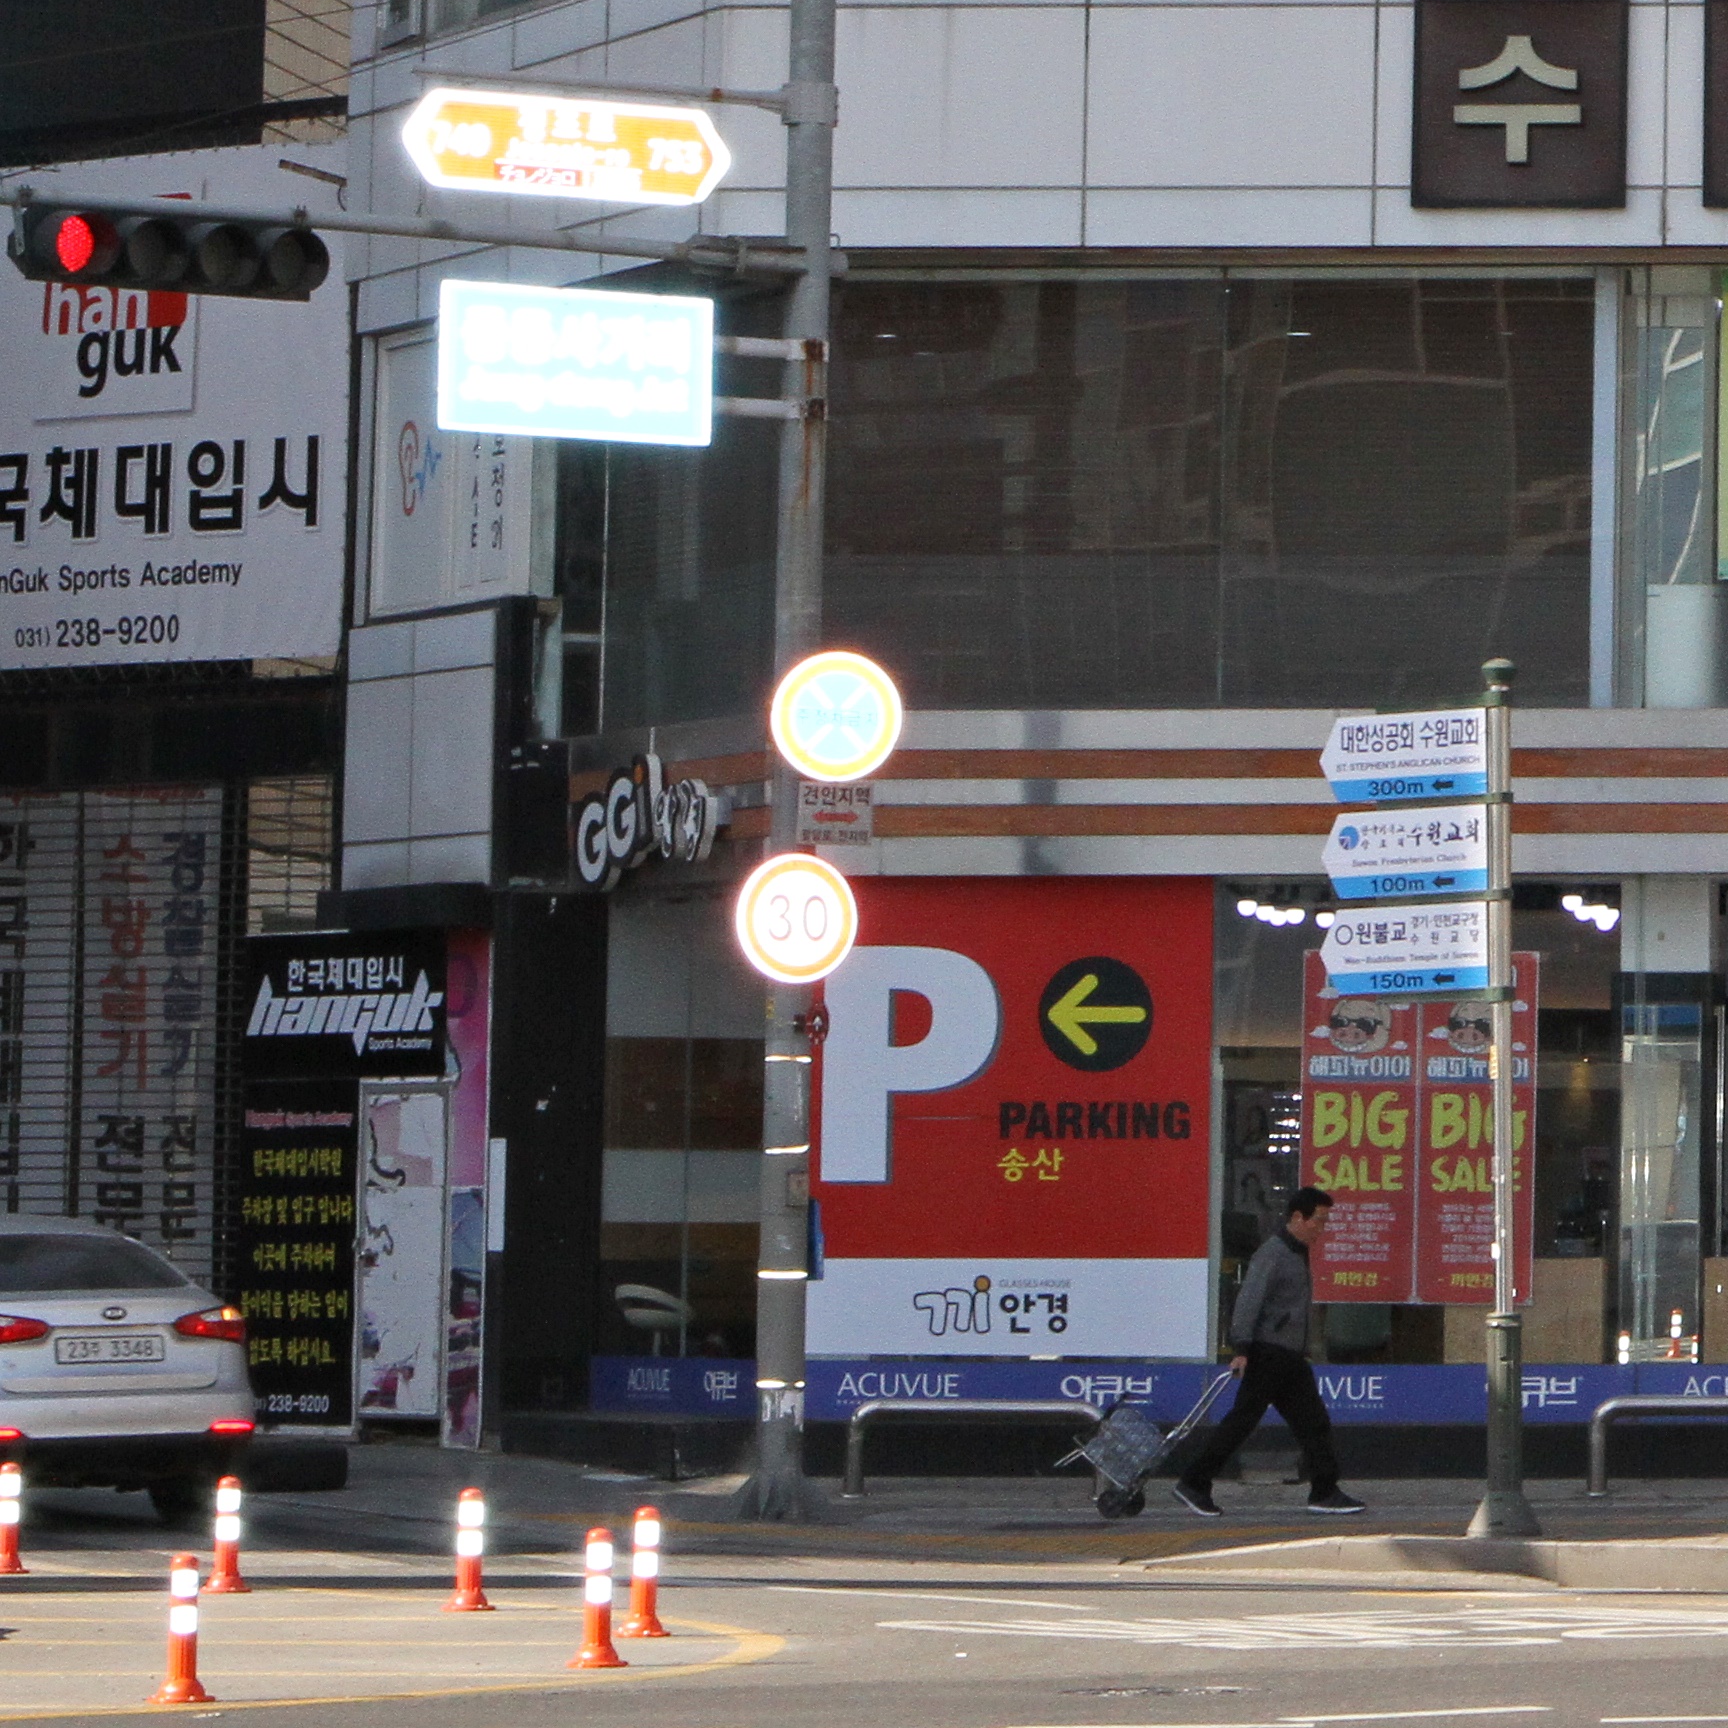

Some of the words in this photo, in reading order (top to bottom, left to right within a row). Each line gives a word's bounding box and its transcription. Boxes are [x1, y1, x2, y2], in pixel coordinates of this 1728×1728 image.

[76, 325, 182, 398] guk
[58, 563, 131, 595] Sports
[140, 558, 243, 589] Academy
[56, 613, 180, 648] 238-9200
[1341, 721, 1415, 754] 대한성공회
[1419, 717, 1480, 749] 수원교회
[803, 785, 871, 807] 견인지역
[1368, 780, 1424, 797] 300m
[1405, 818, 1480, 846] 수원교회
[1371, 877, 1425, 893] 100m
[768, 893, 827, 941] 30
[1355, 922, 1407, 946] 원불교
[288, 956, 404, 993] 한국체대입시
[1370, 973, 1424, 989] 150m
[819, 945, 998, 1184] P
[999, 1100, 1192, 1141] PARKING
[1312, 1090, 1409, 1150] BIG
[996, 1147, 1065, 1182] 송산
[1313, 1154, 1404, 1191] SALE
[1000, 1293, 1069, 1334] 안경
[836, 1371, 960, 1398] ACUVUE
[1060, 1374, 1155, 1405] 아큐브
[268, 1393, 330, 1413] 238-9200
